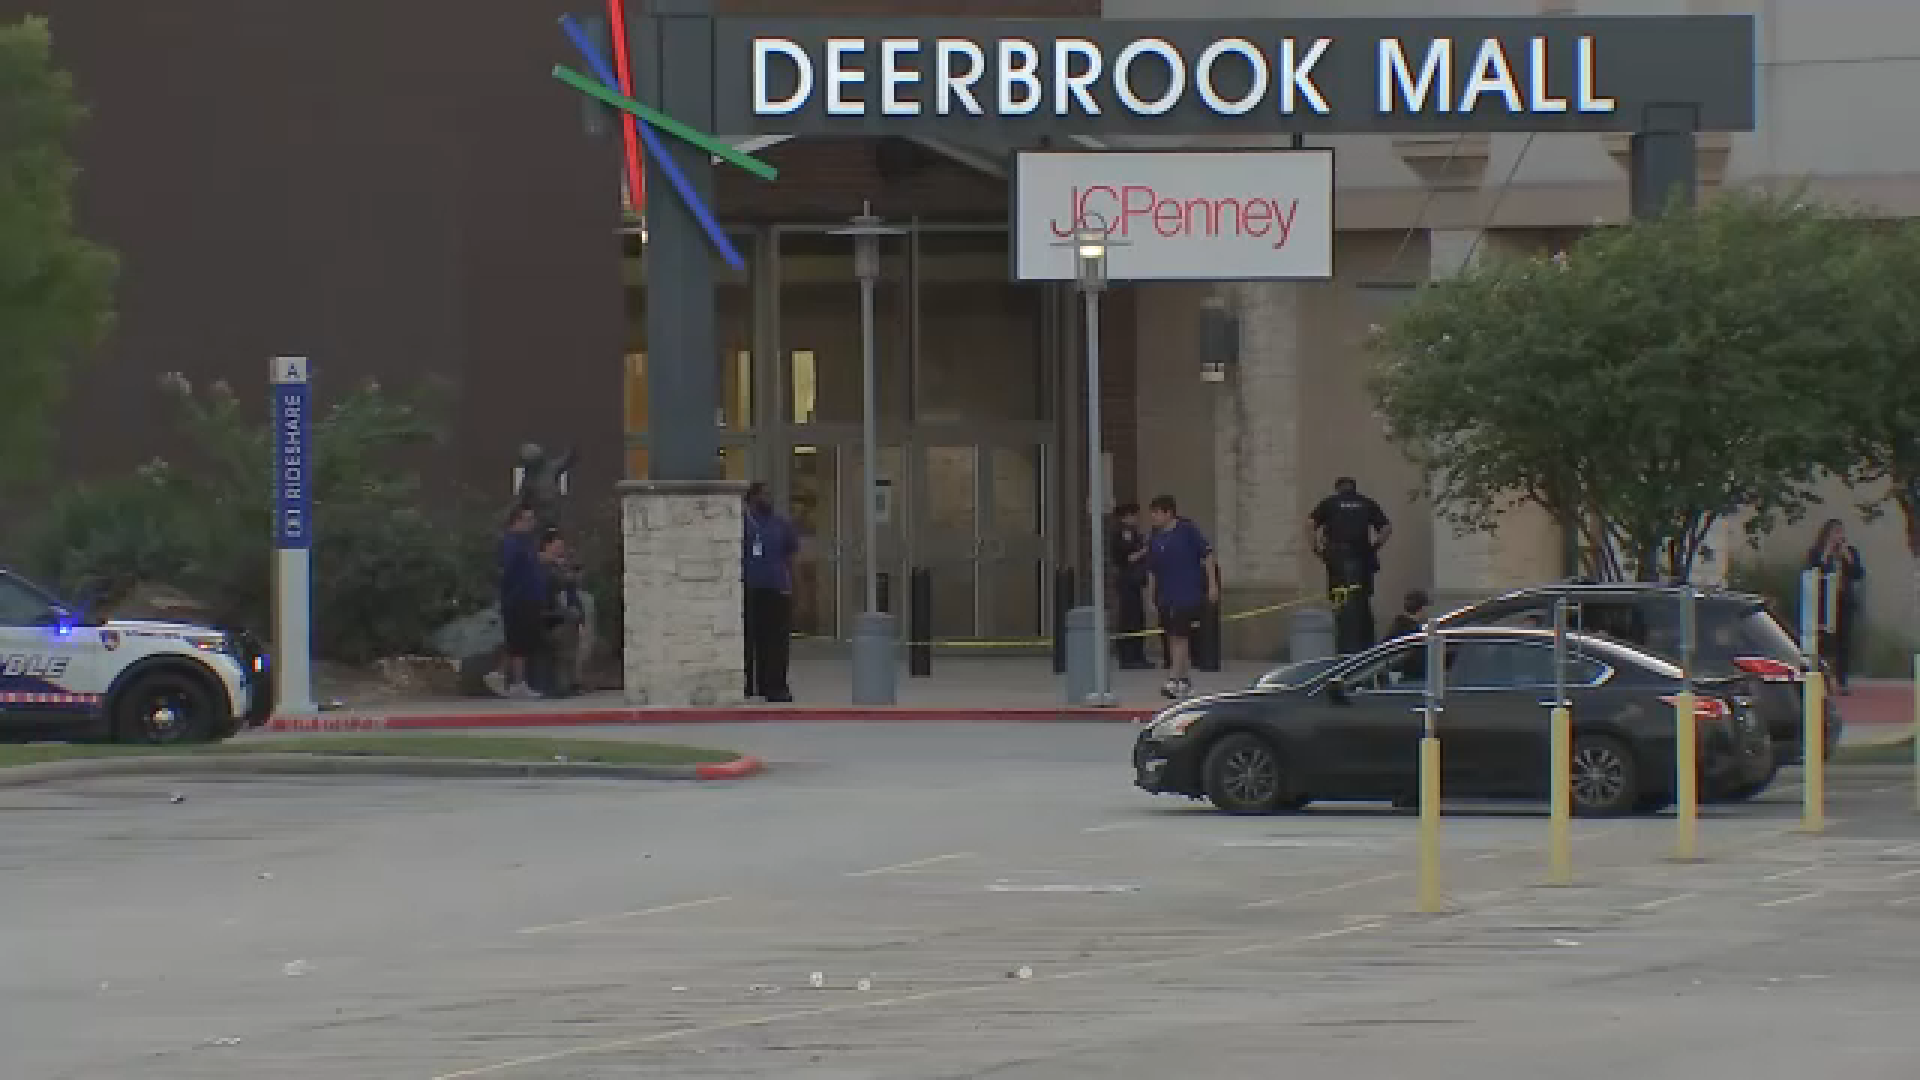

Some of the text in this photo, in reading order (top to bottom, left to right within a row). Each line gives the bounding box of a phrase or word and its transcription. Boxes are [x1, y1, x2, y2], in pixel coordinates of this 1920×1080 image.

[752, 36, 1616, 115] DEERBROOK MALL
[1050, 184, 1300, 250] JCPenney
[285, 361, 301, 379] A
[284, 395, 301, 498] RIDESHARE
[0, 654, 72, 678] BLE
